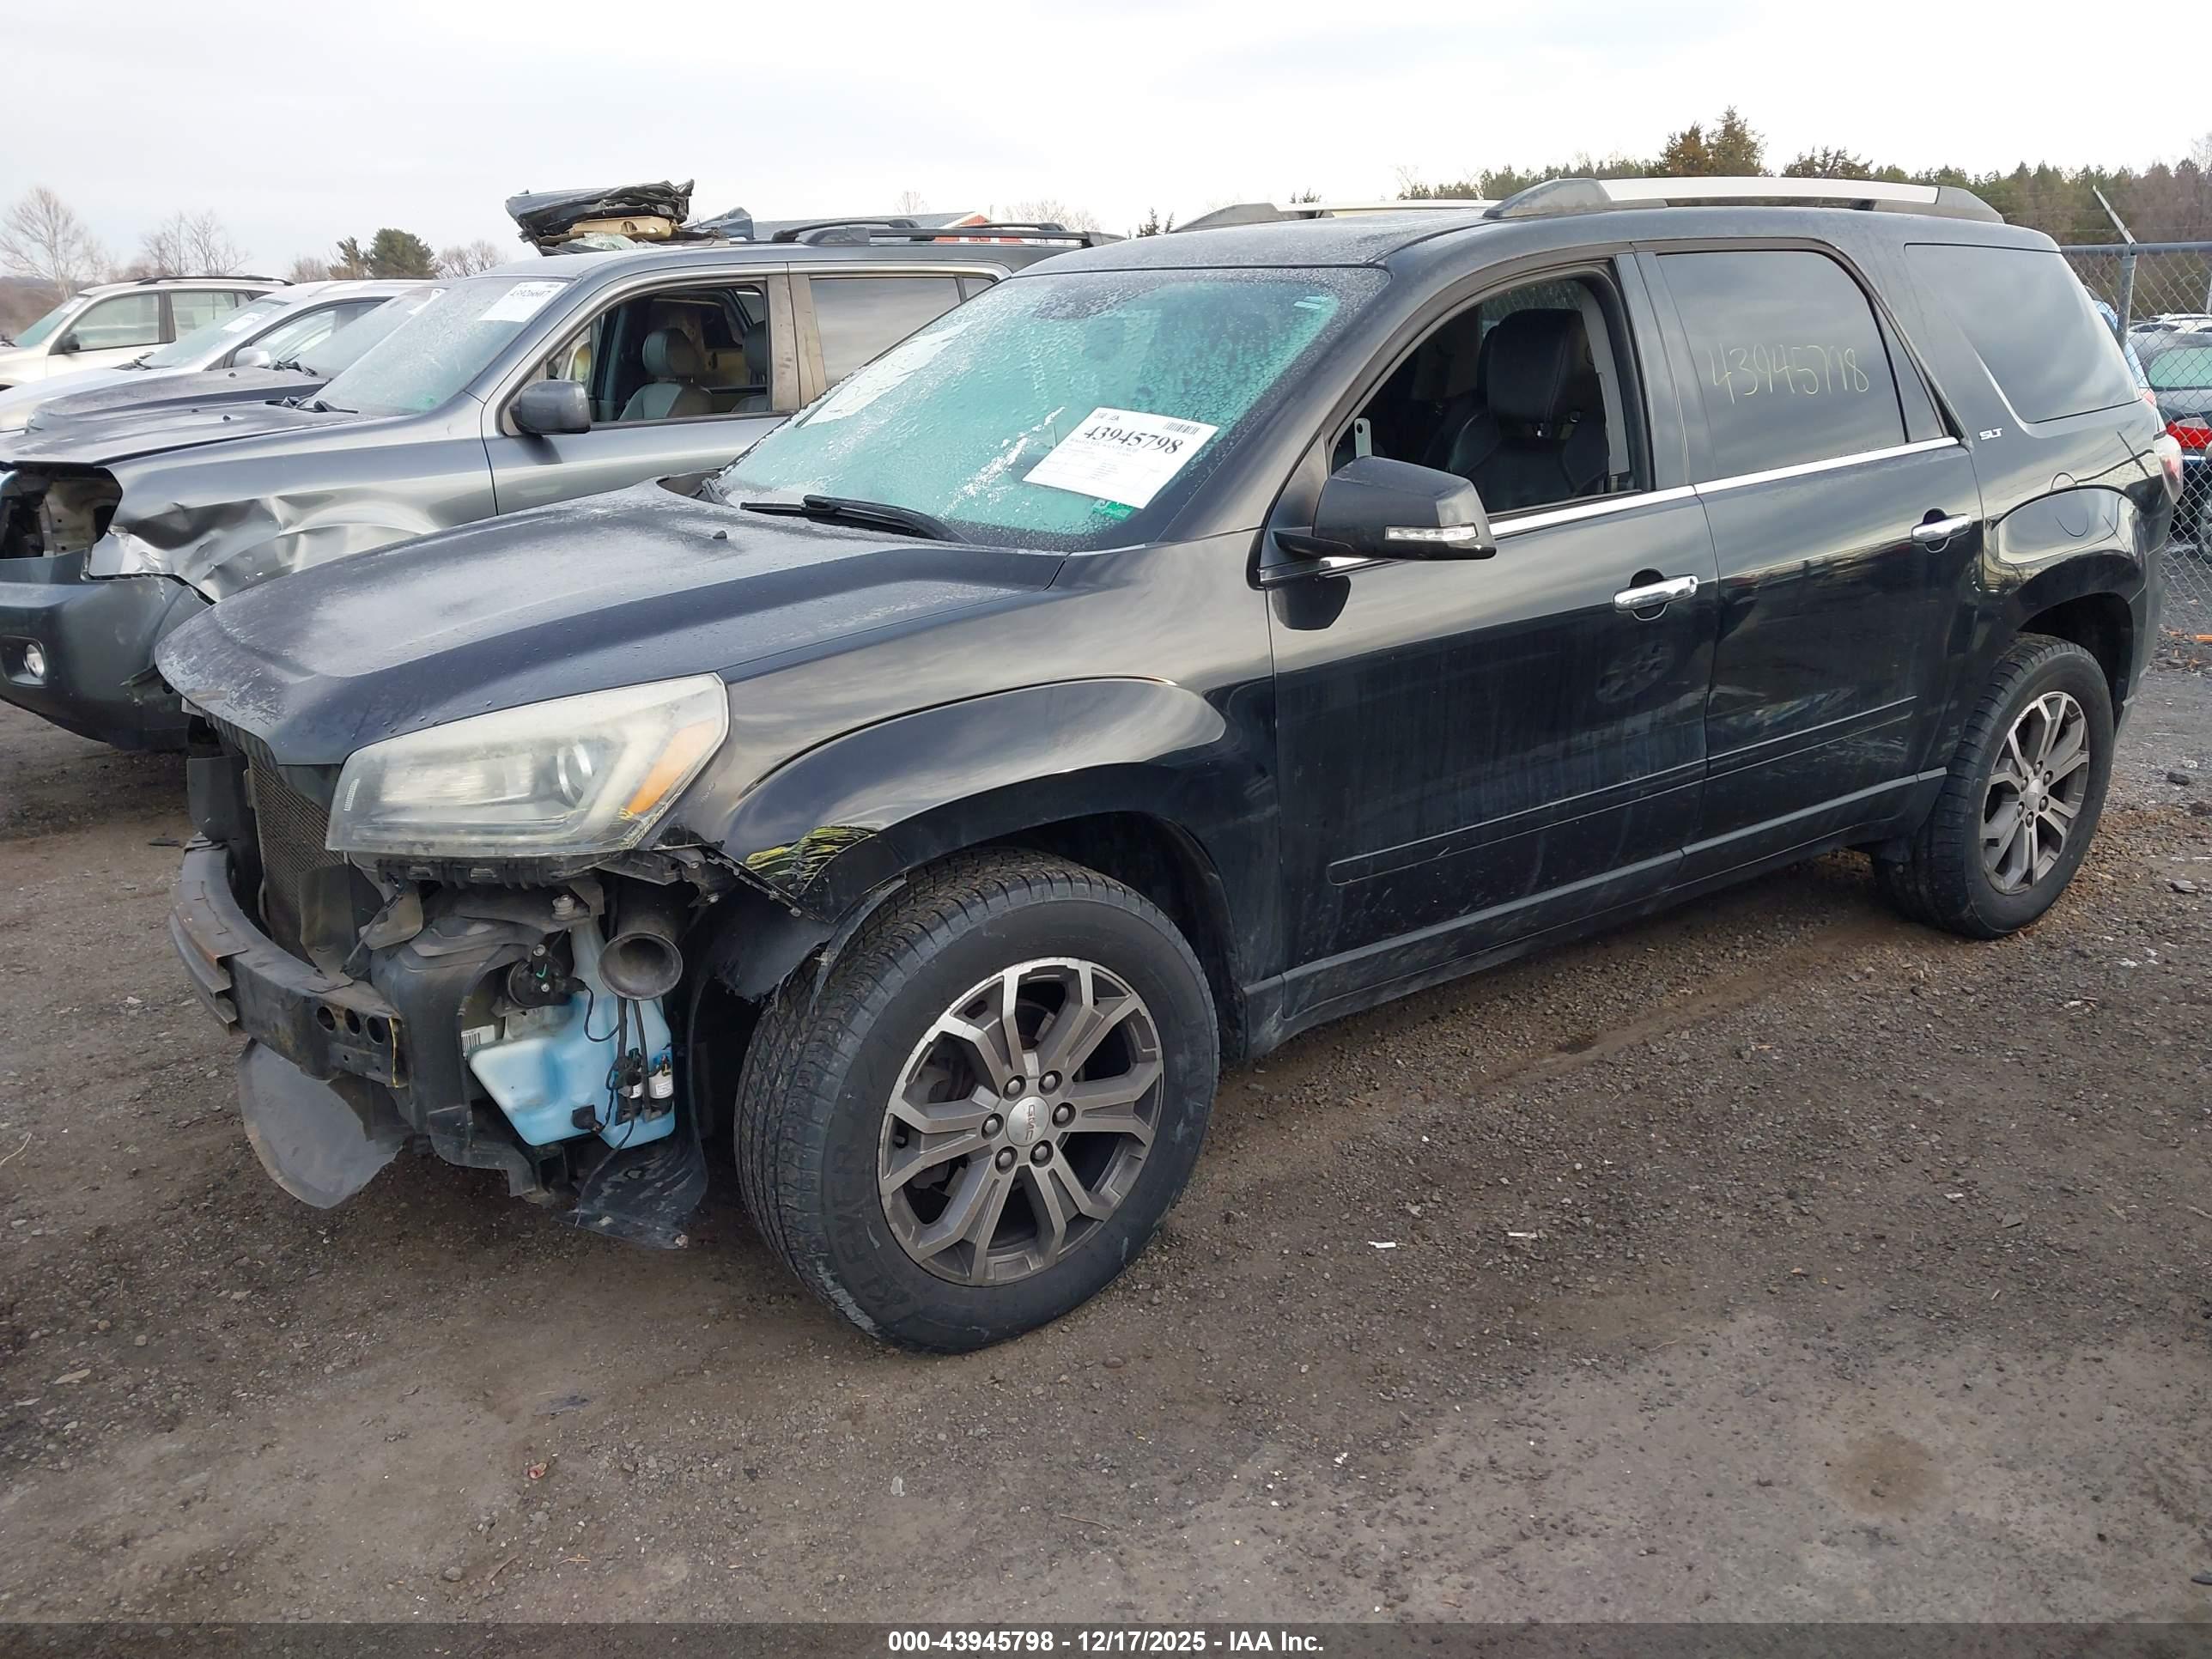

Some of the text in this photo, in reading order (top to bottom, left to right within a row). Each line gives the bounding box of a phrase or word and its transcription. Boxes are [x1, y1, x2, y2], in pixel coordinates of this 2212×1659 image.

[1084, 425, 1184, 453] 43945798
[1978, 428, 2003, 441] SLT
[1024, 1104, 1036, 1141] GMC
